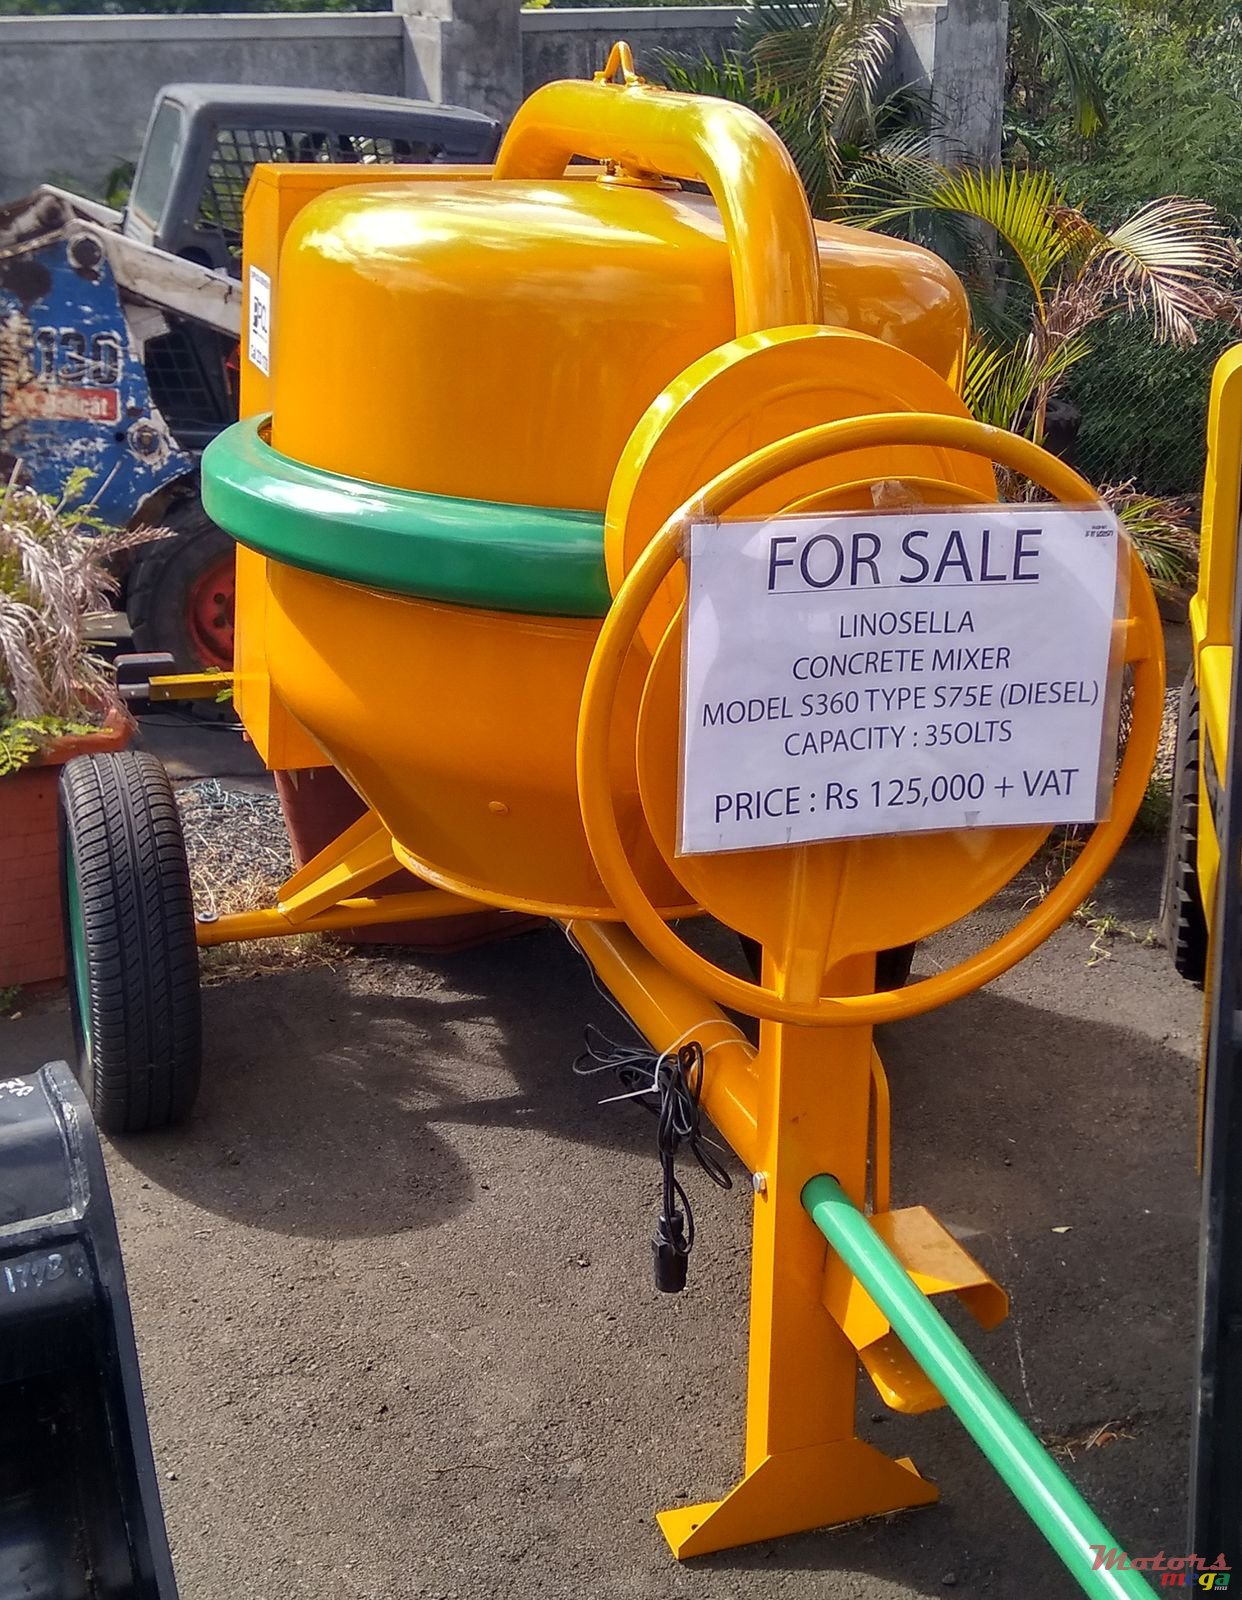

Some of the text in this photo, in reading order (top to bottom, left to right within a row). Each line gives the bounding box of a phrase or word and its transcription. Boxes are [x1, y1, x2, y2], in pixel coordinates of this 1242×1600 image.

[768, 529, 1042, 591] FOR SALE
[840, 611, 974, 638] LINOSELLA
[793, 647, 1010, 680] CONCRETE MIXER
[703, 681, 1098, 727] MODEL S360 TYPE S75E (DIESEL)
[785, 726, 905, 756] CAPACITY
[716, 787, 800, 823] PRICE
[826, 783, 858, 810] Rs
[872, 773, 984, 807] 125,000
[994, 777, 1014, 798] +
[1023, 769, 1079, 796] VAT
